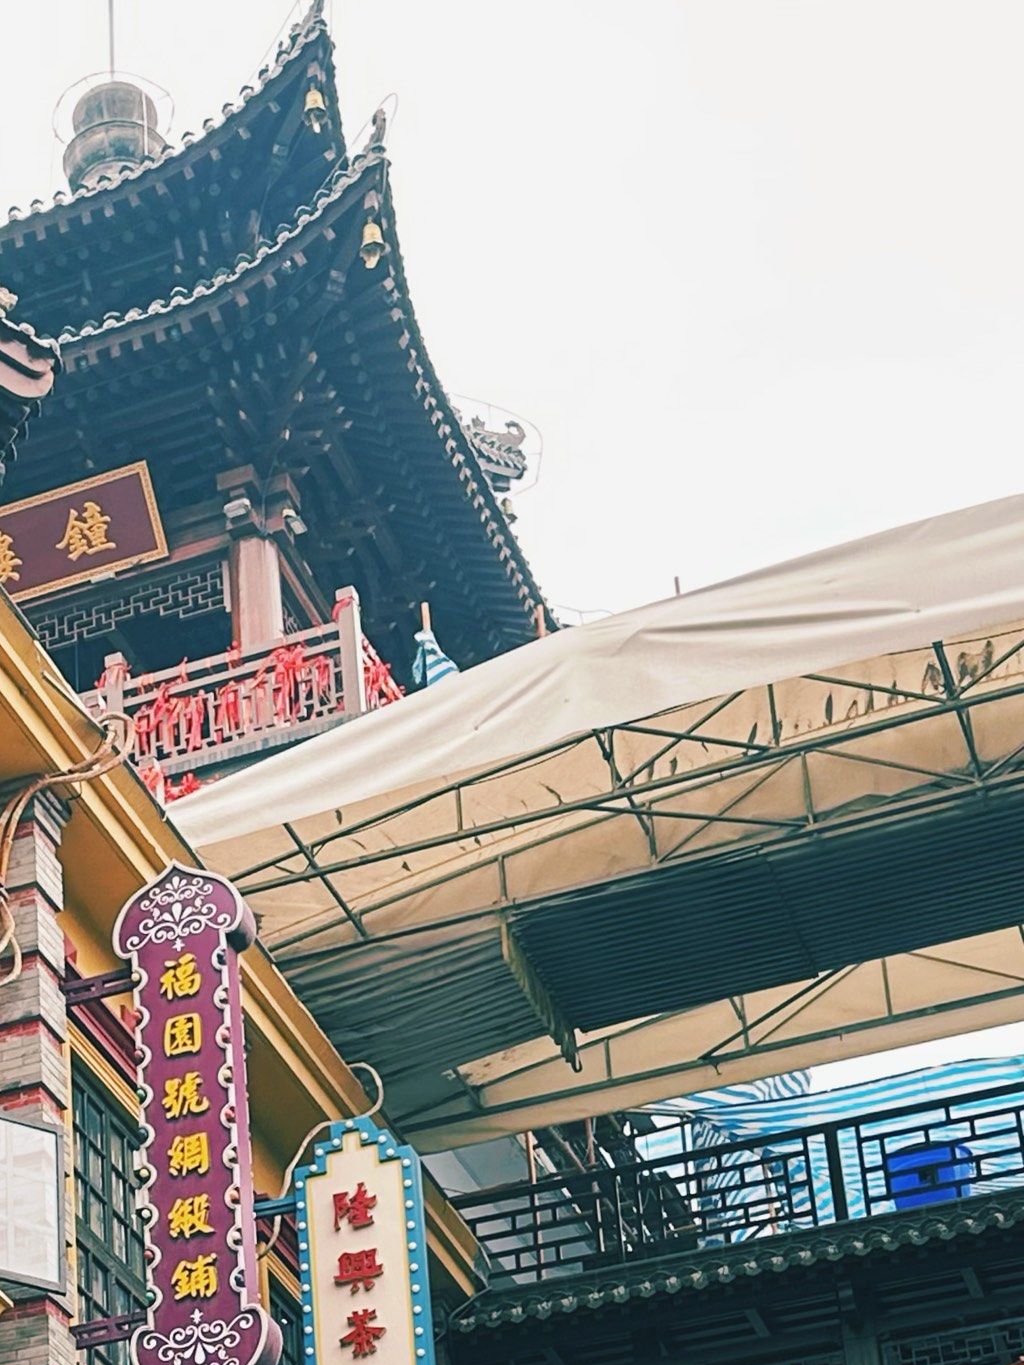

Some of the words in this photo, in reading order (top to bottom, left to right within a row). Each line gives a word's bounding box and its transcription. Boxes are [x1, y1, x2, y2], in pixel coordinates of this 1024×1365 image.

[160, 953, 218, 1299] 福園號綢緞鋪
